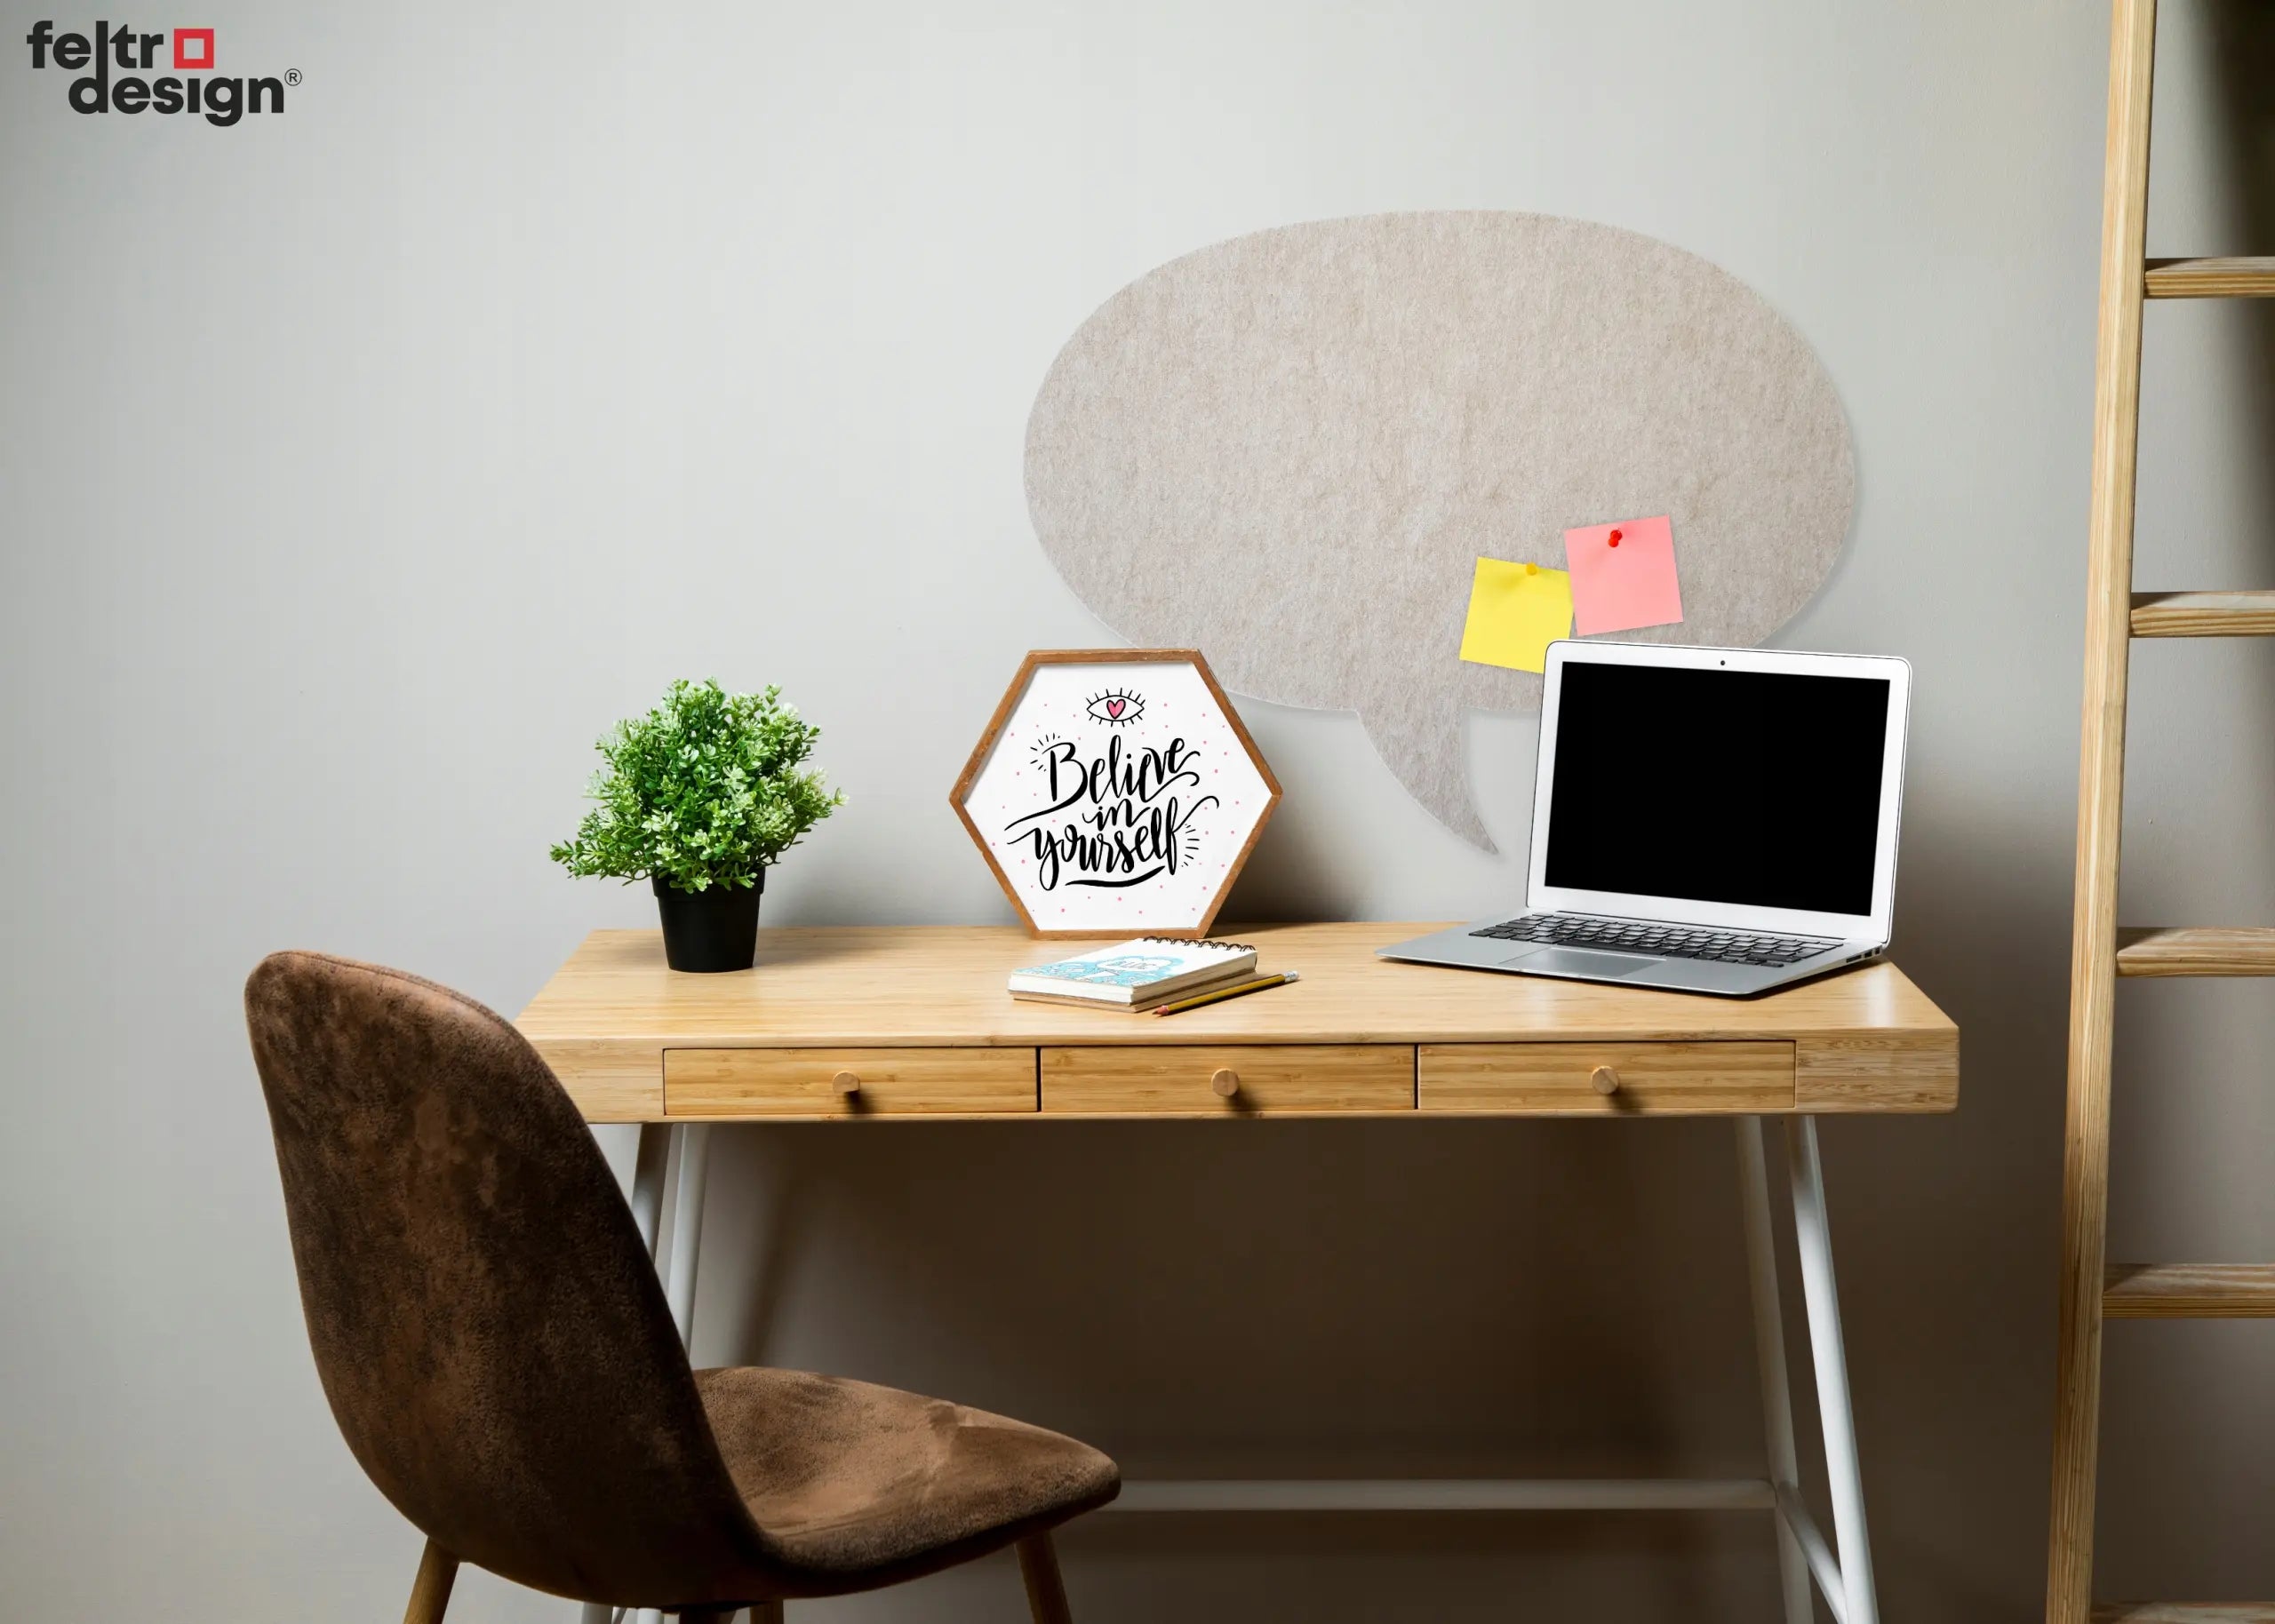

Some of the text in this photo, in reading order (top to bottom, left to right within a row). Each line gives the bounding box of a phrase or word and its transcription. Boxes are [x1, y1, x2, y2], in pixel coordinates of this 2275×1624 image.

[1005, 735, 1201, 831] Believe
[1082, 798, 1151, 832] in
[1007, 796, 1219, 891] yourself
